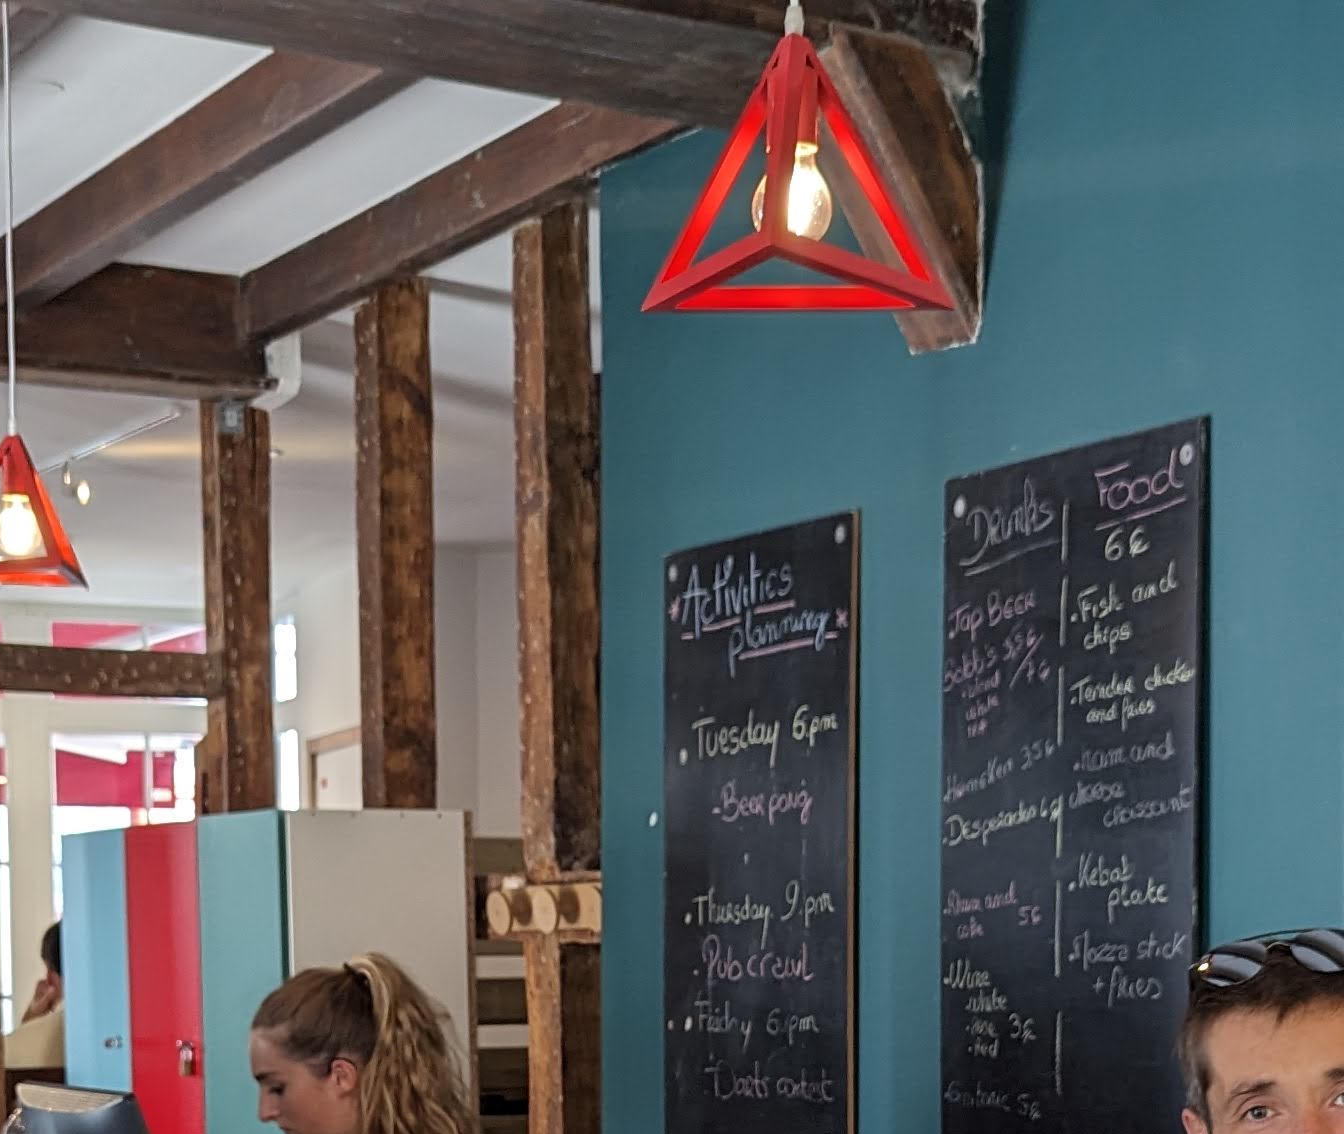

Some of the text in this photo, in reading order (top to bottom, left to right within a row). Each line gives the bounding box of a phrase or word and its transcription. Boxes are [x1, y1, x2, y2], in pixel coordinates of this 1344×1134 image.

[1094, 448, 1185, 511] Food
[959, 476, 1055, 566] Drinks
[948, 591, 1036, 642] Tap Beer
[1077, 559, 1177, 622] Fish and
[1083, 621, 1133, 653] chips
[691, 708, 781, 769] Tuesday
[693, 886, 770, 950] Thursday
[1107, 877, 1170, 924] plate
